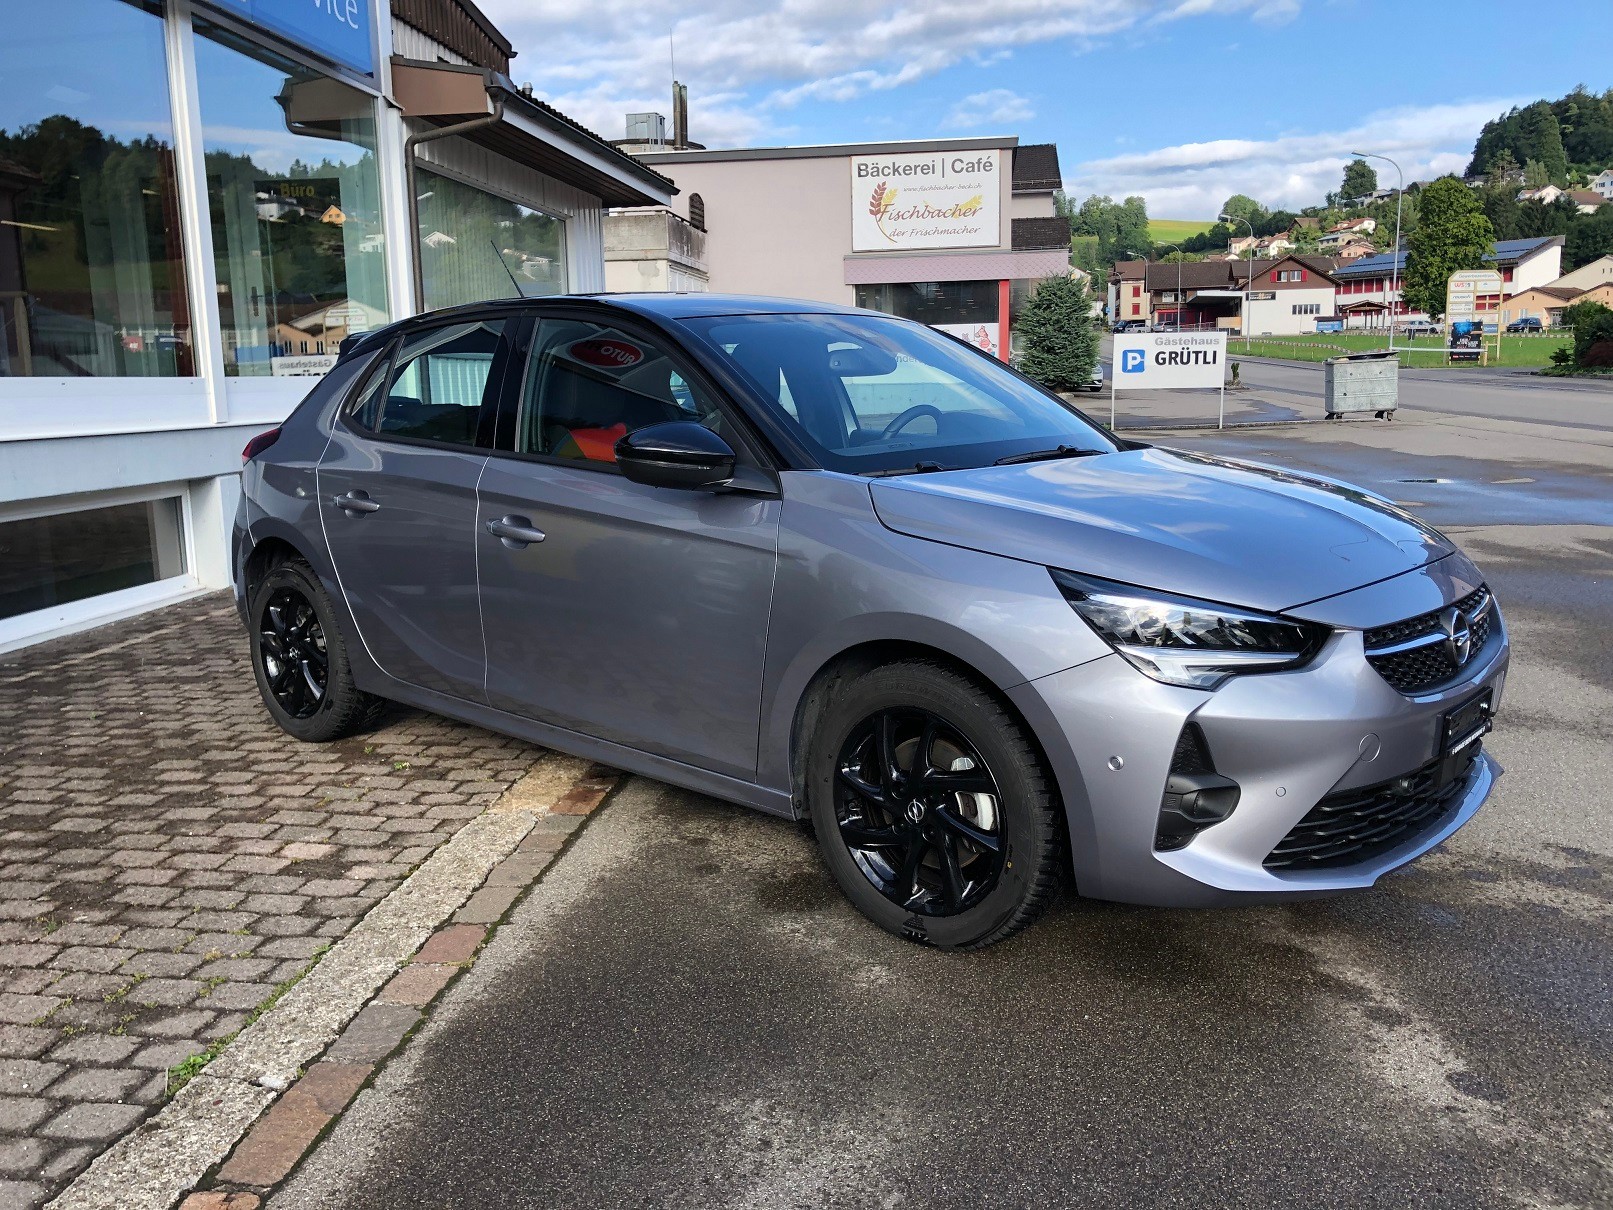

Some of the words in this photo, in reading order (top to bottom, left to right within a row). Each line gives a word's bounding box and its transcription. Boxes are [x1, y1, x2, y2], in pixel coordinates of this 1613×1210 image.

[312, 0, 359, 29] ce
[857, 160, 936, 178] Bäckerei
[951, 156, 994, 174] Café
[280, 183, 315, 198] Büro
[876, 203, 983, 223] Fischbacher
[888, 228, 908, 238] der
[909, 226, 981, 238] Frischmacher
[1154, 336, 1220, 346] Gästehaus
[1126, 352, 1142, 371] P
[1154, 346, 1217, 366] GRÜTLI
